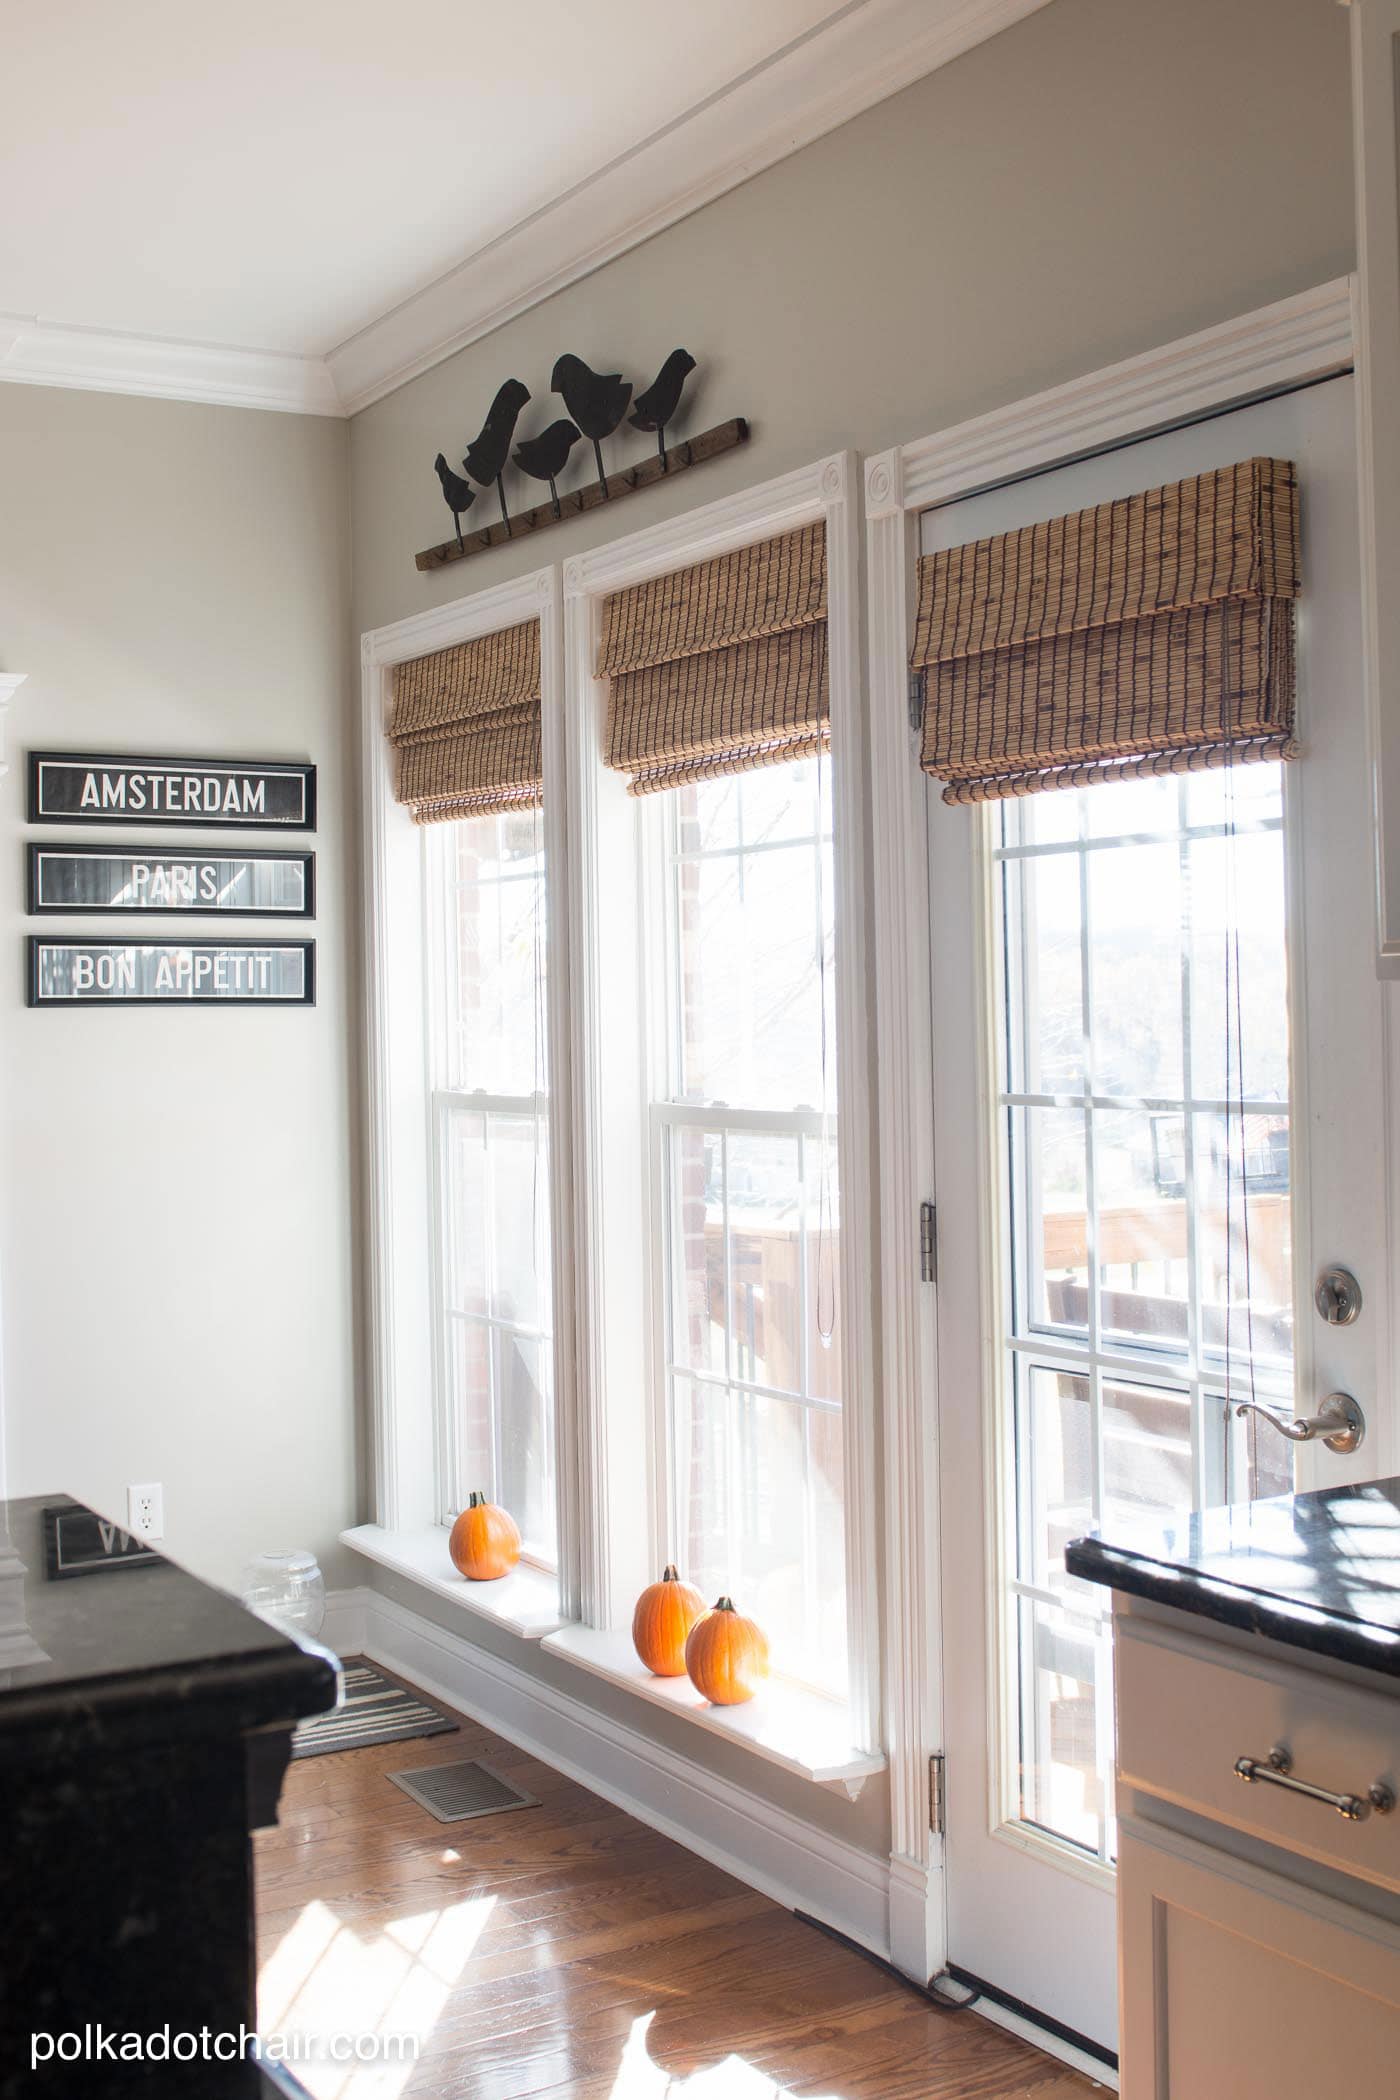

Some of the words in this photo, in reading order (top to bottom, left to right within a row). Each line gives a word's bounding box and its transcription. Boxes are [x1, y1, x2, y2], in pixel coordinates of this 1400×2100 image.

[80, 772, 266, 814] AMSTERDAM
[131, 864, 217, 900] PARIS
[75, 955, 136, 990] BON
